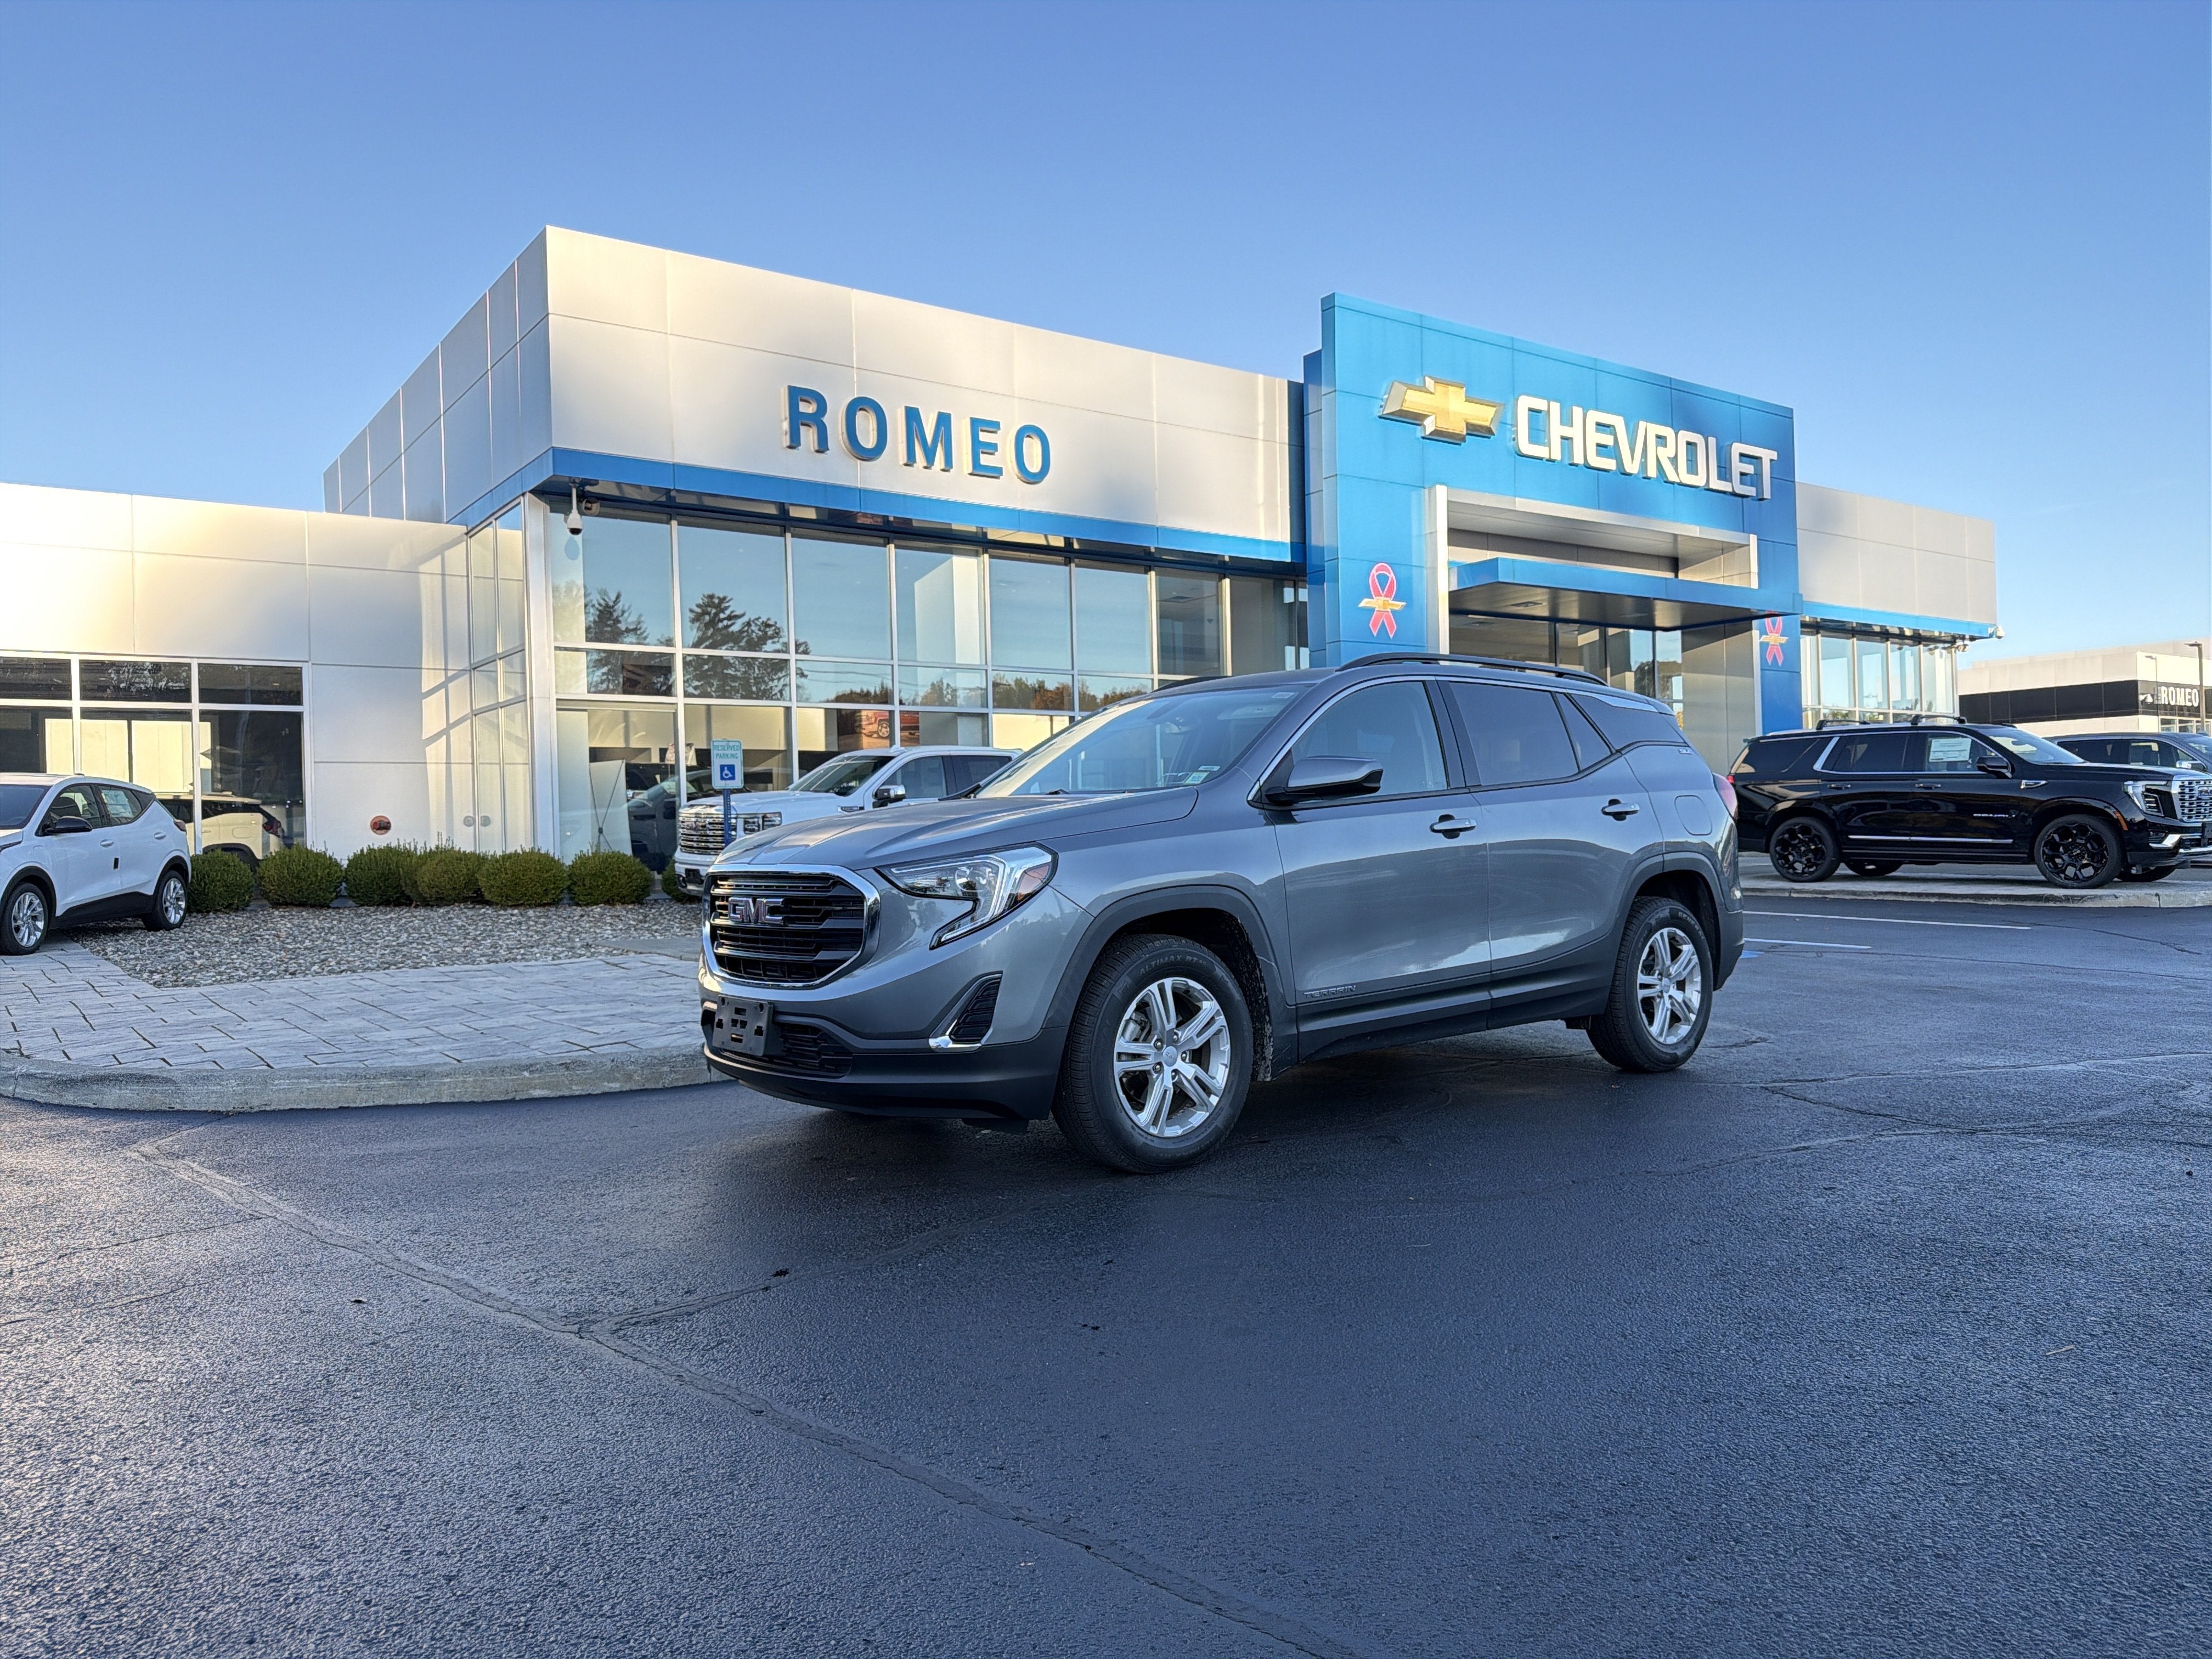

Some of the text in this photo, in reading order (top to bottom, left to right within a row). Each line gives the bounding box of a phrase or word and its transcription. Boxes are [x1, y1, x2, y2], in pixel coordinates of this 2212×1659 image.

[785, 385, 1051, 485] ROMEO
[1517, 395, 1778, 500] CHEVROLET
[2160, 686, 2199, 707] ROMEO
[728, 897, 783, 923] GMC
[1140, 955, 1182, 975] ALTIMAX
[1304, 985, 1356, 998] TERRAIN
